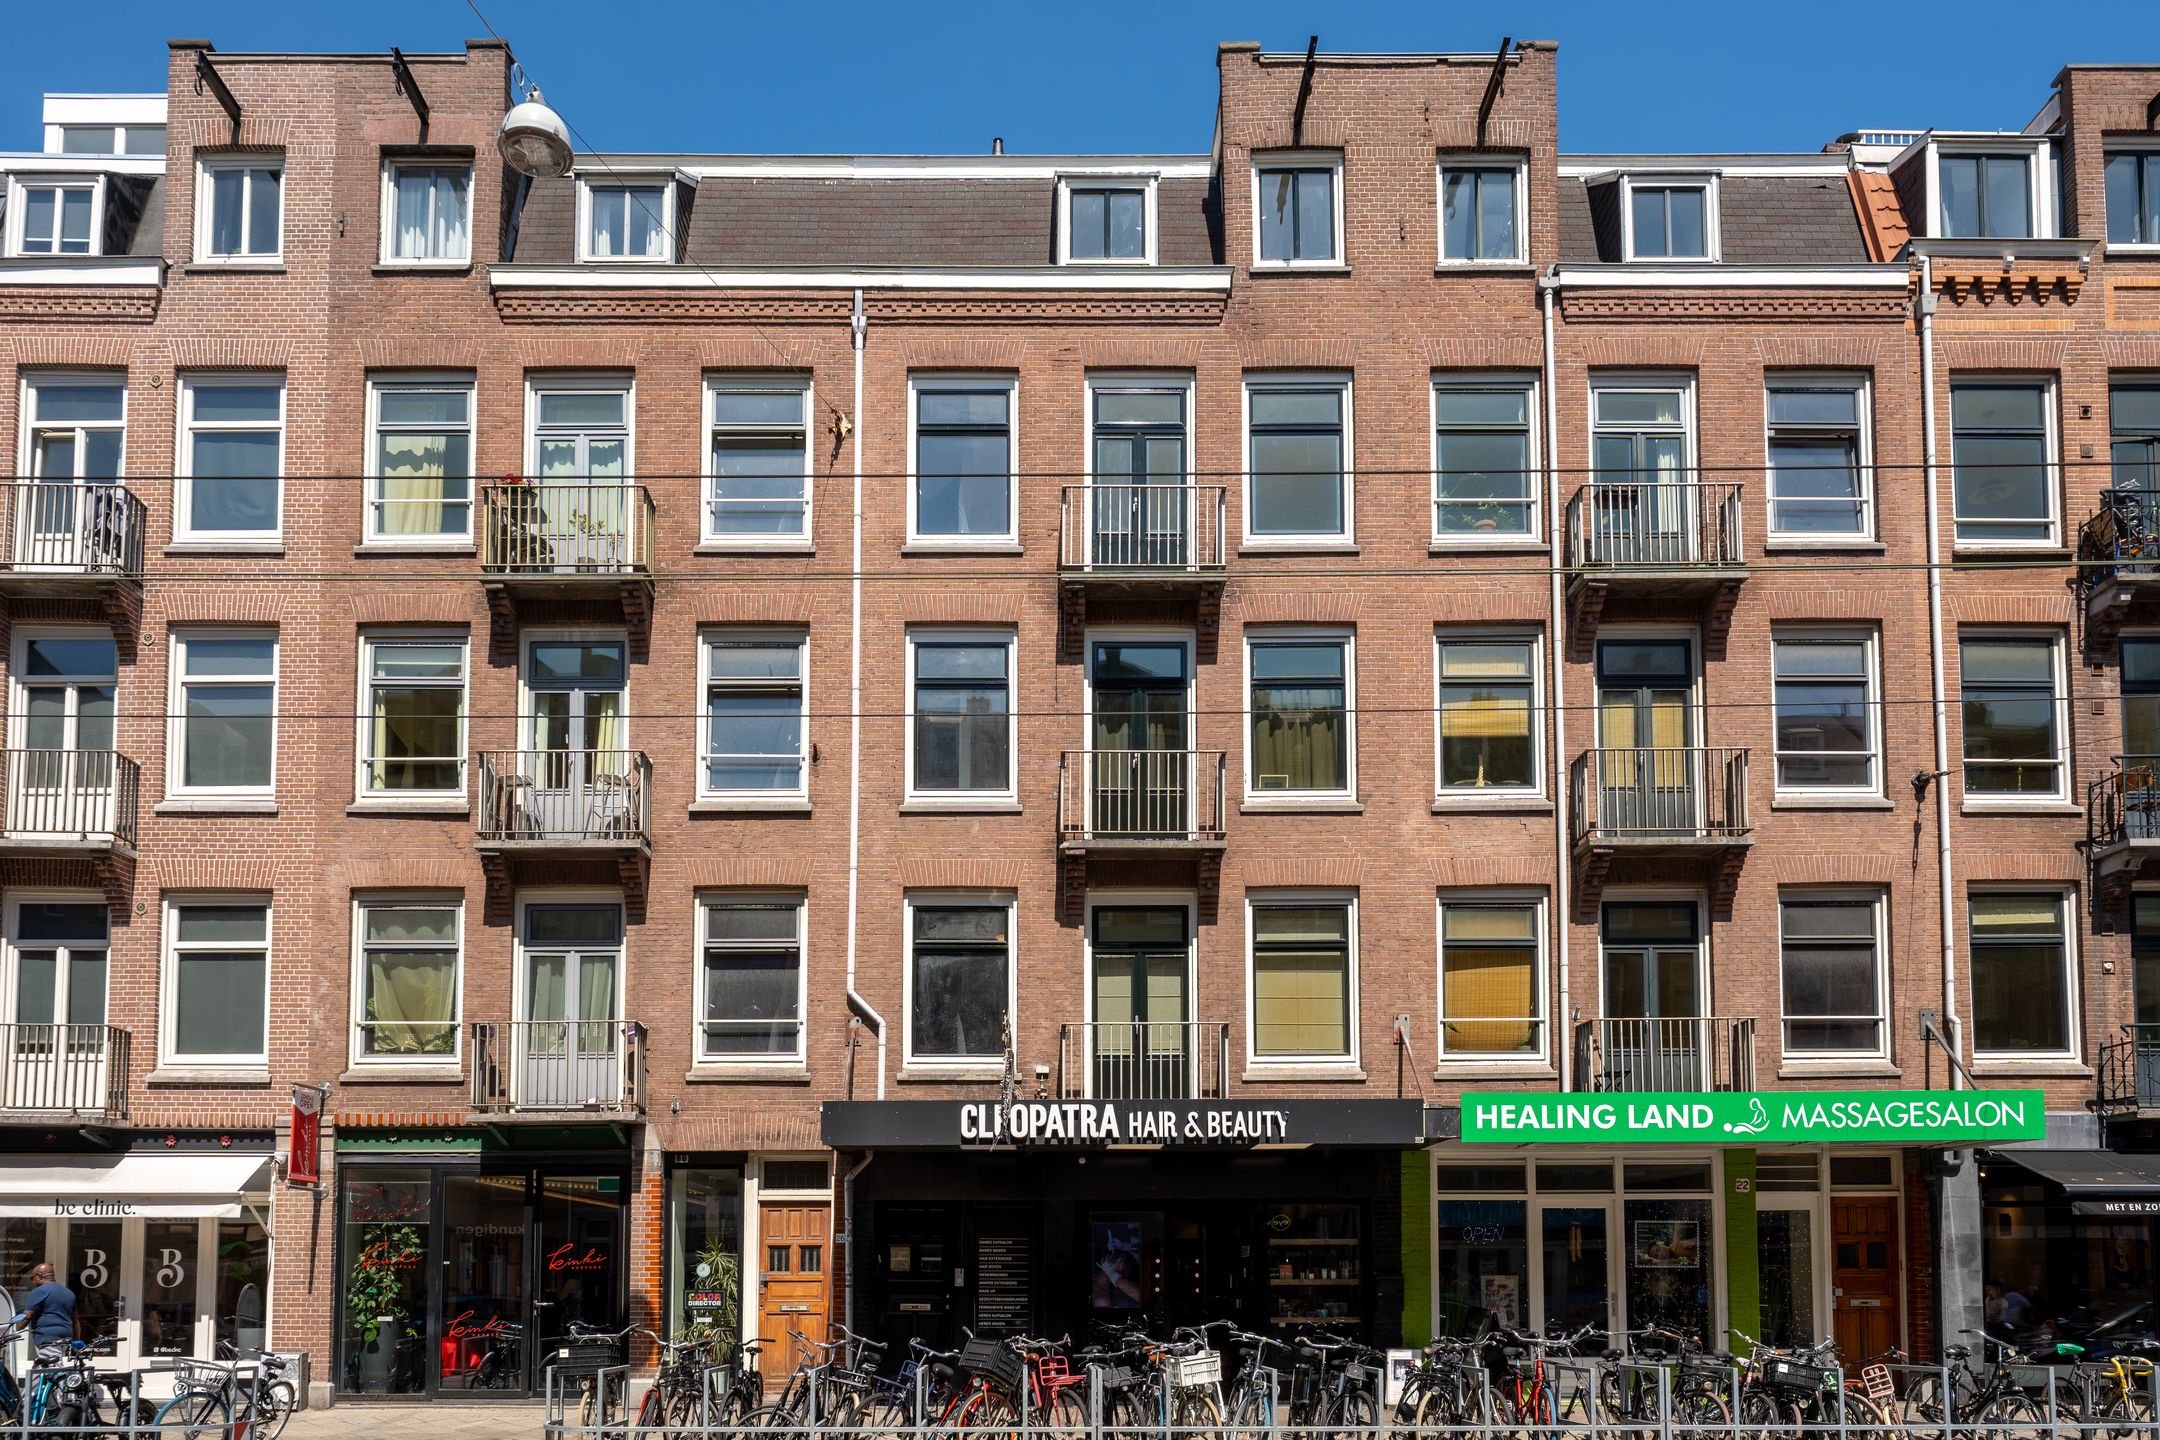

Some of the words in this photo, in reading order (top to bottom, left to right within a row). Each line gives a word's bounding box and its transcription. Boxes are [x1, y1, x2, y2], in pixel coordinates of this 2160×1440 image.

[1476, 1104, 1617, 1129] HEALING
[1628, 1104, 1714, 1129] LAND
[1782, 1100, 2025, 1128] MASSAGESALON
[1128, 1110, 1177, 1138] HAIR
[1184, 1110, 1204, 1138] &
[1207, 1110, 1289, 1138] BEAUTY
[1736, 1180, 1749, 1190] 22
[55, 1198, 77, 1216] be
[82, 1198, 137, 1216] clinic.
[2105, 1203, 2126, 1211] MET
[2128, 1203, 2142, 1211] EN
[2144, 1203, 2160, 1211] ZO
[836, 1234, 845, 1242] 26
[1462, 1226, 1505, 1242] OPEN
